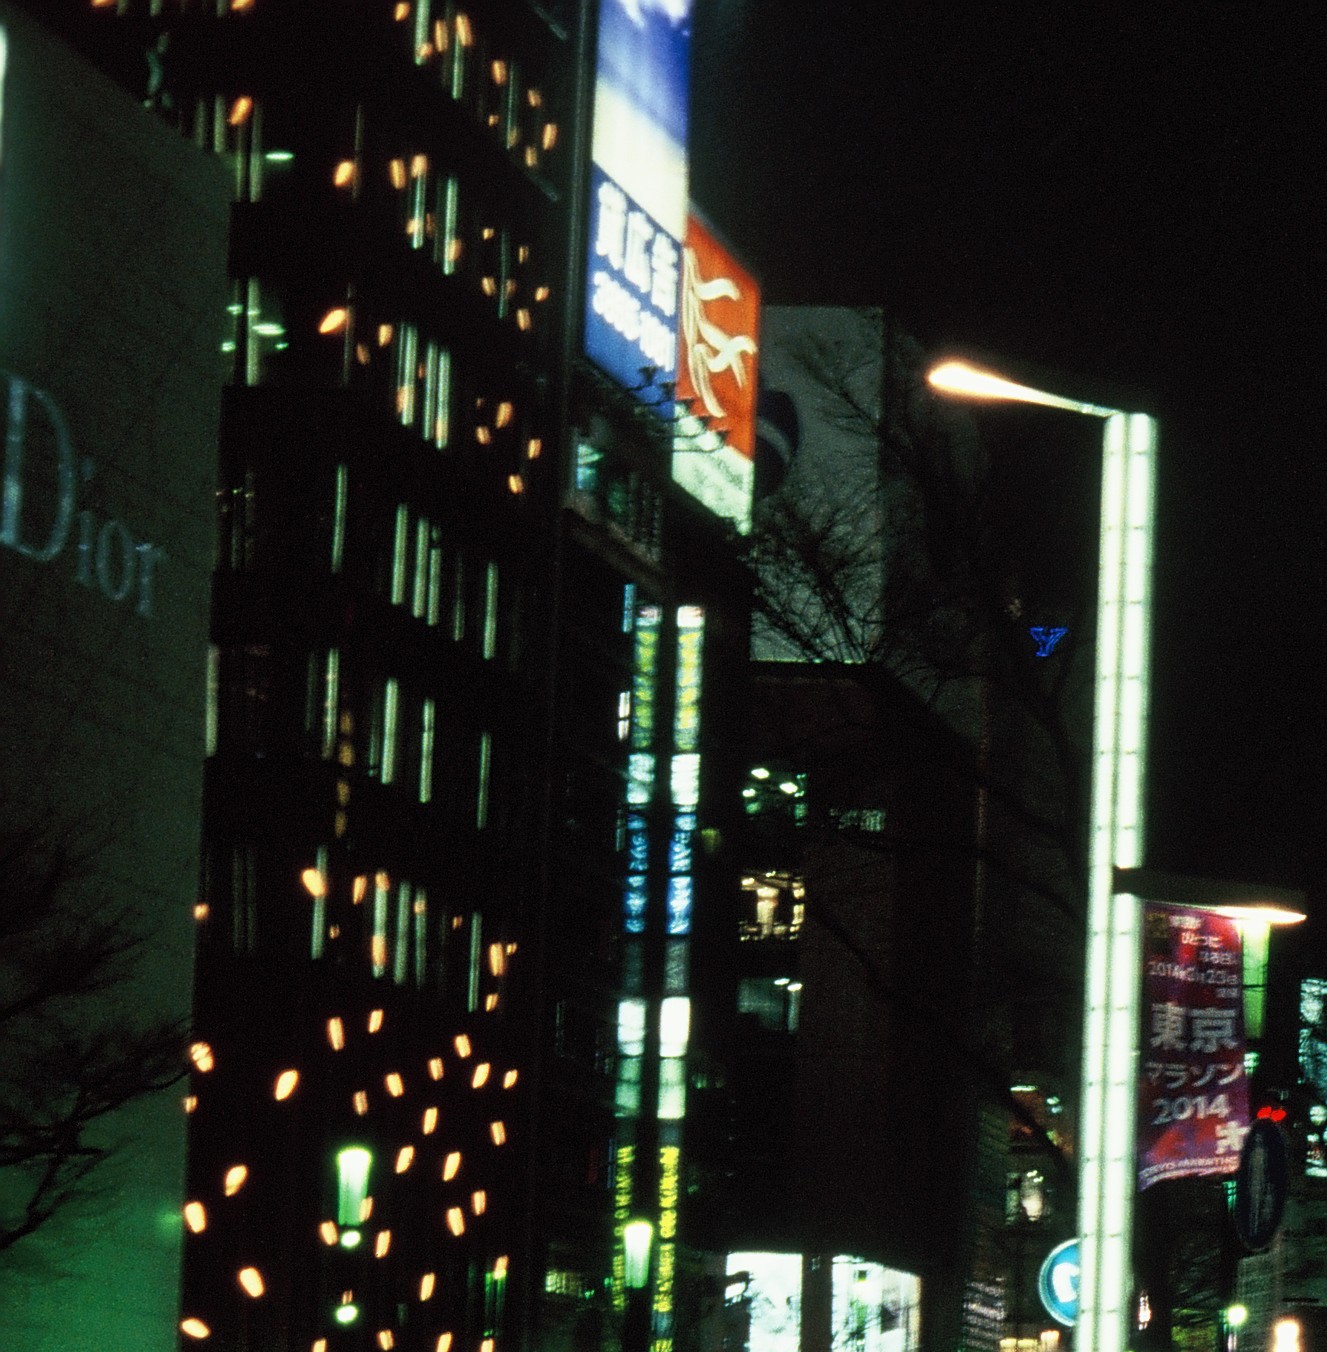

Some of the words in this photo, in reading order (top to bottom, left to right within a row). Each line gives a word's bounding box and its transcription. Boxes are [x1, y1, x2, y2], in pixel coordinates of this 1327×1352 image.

[0, 369, 168, 617] Dior
[1150, 1002, 1239, 1052] 東京
[1145, 1061, 1244, 1088] マラソン
[1151, 1094, 1230, 1125] 2014
